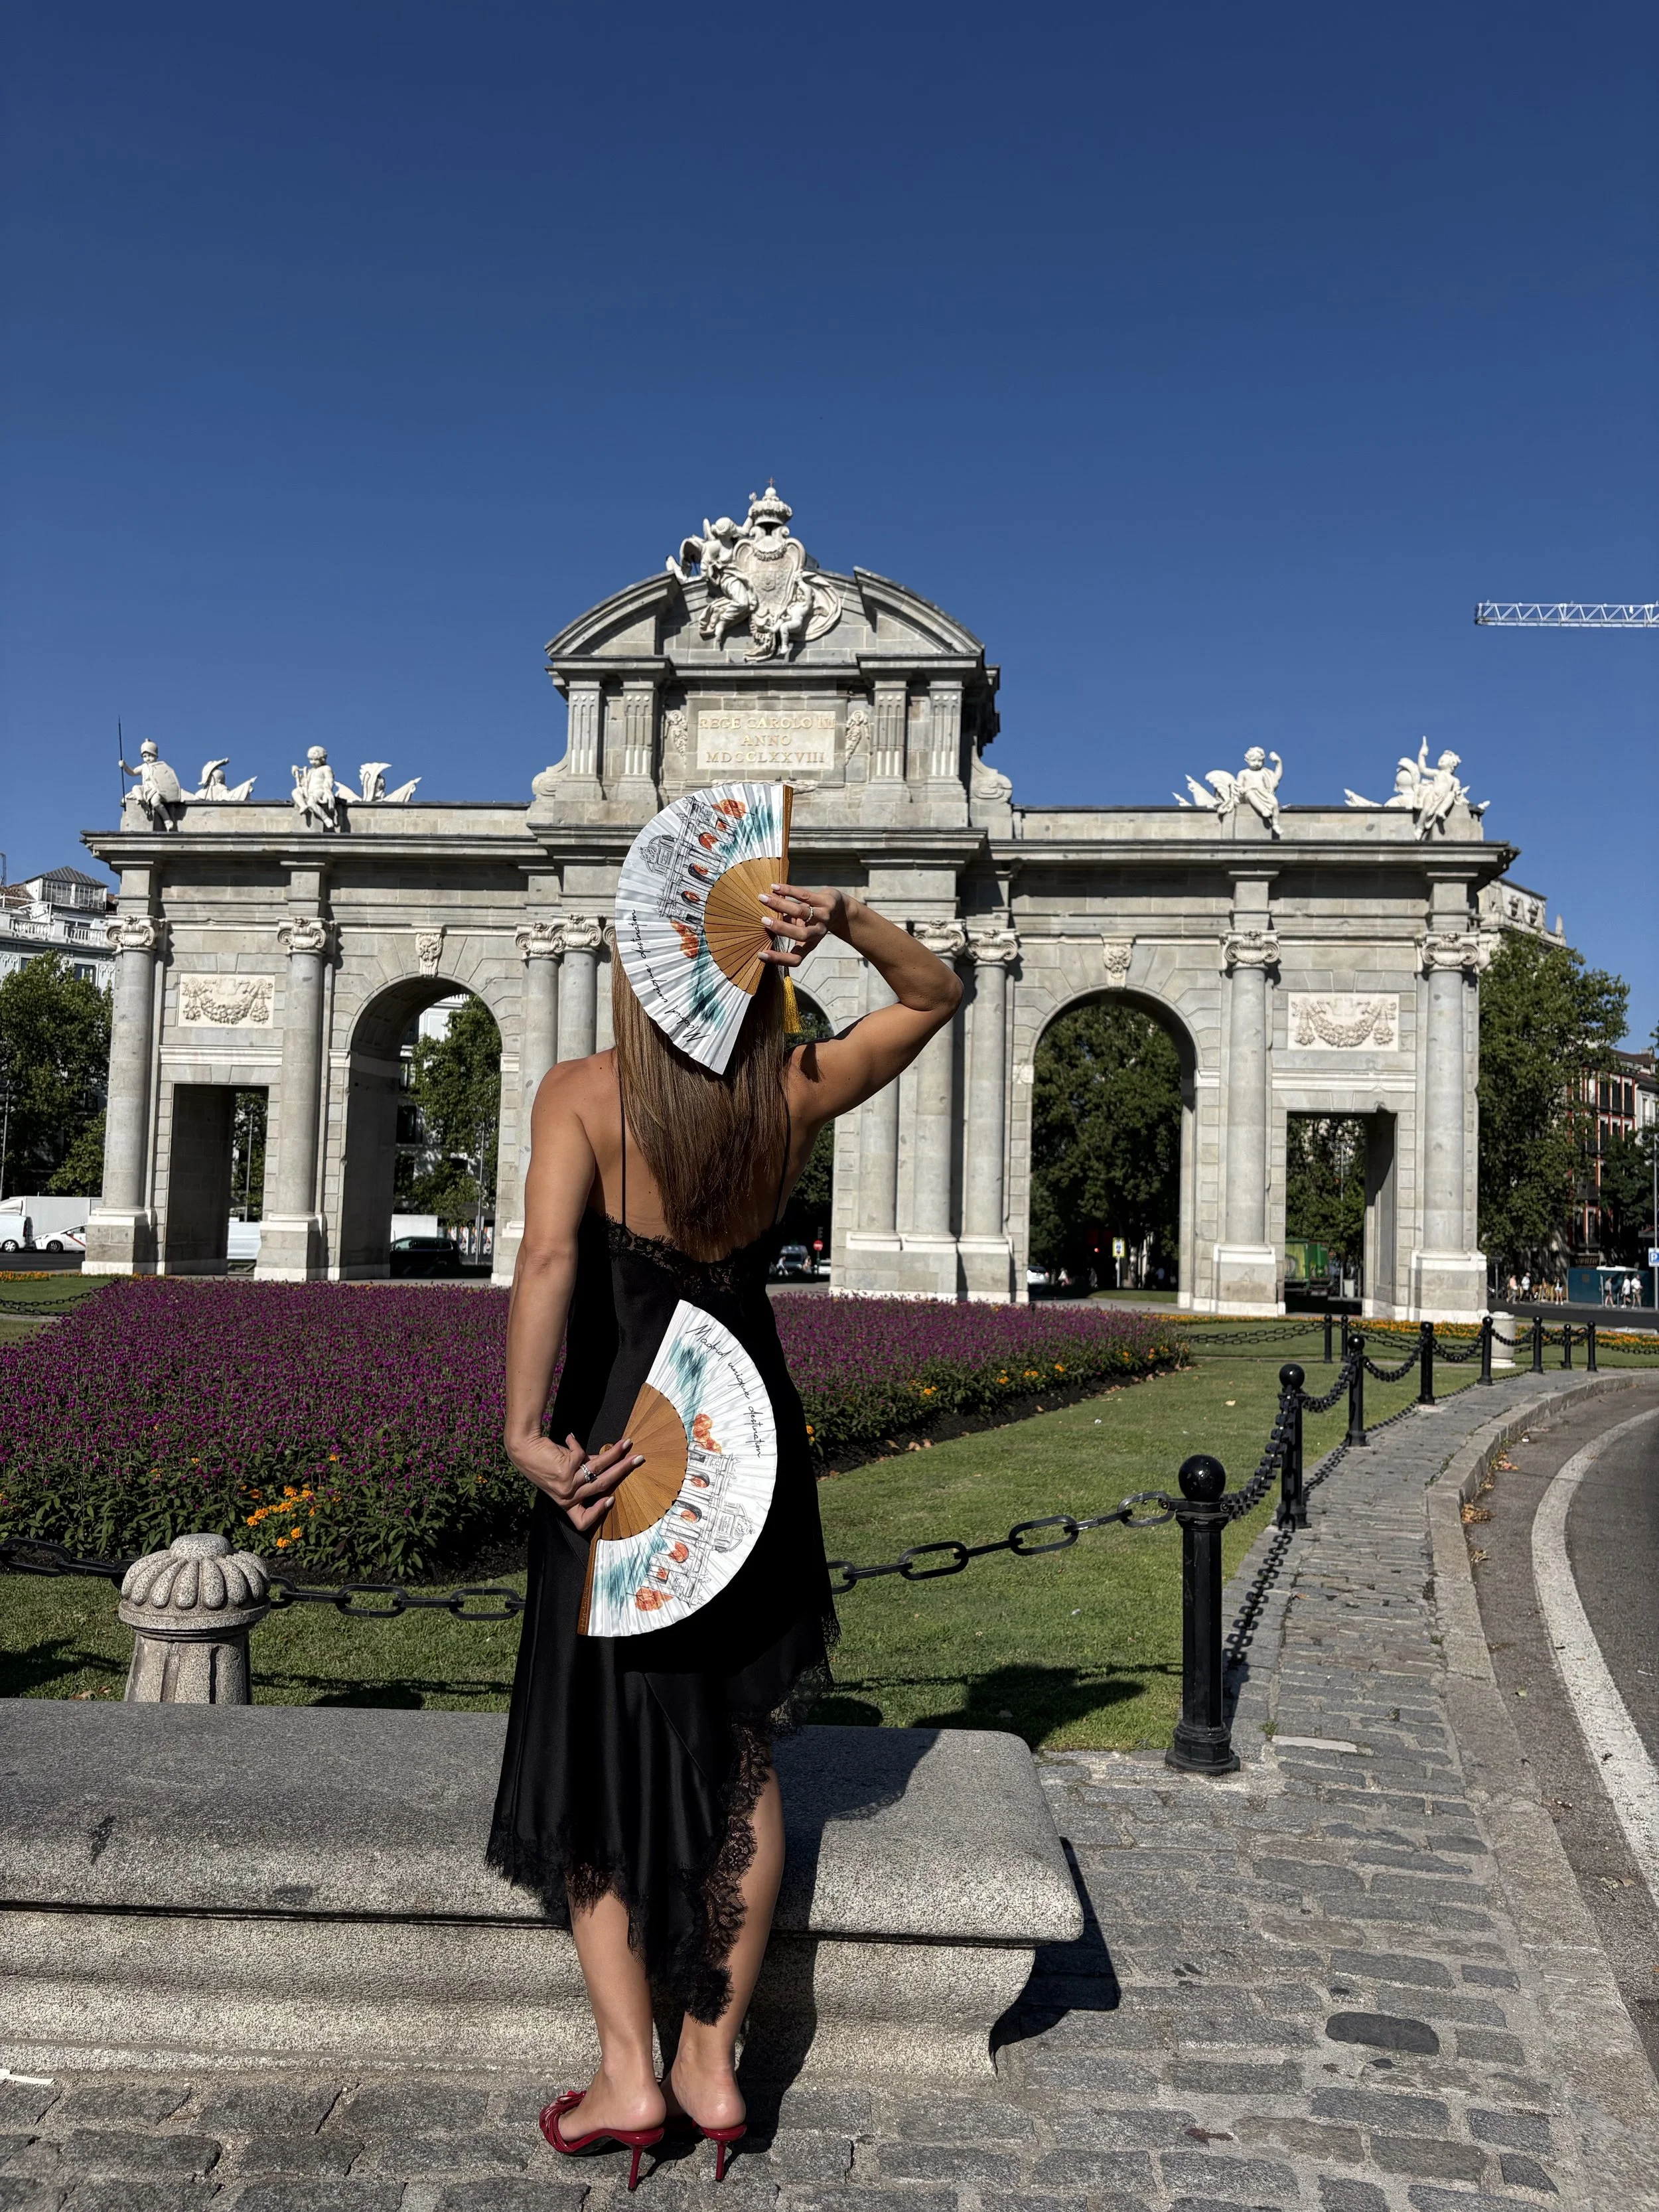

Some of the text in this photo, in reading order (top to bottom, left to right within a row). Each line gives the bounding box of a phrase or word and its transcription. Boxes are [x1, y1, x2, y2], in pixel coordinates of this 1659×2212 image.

[747, 717, 813, 729] CAROLO
[741, 734, 792, 746] ANNO
[706, 751, 825, 763] MDCCLXXVIII
[628, 909, 711, 1042] Madrid unique destination
[1651, 1253, 1658, 1262] P
[685, 1324, 765, 1458] Madrid unique destination
